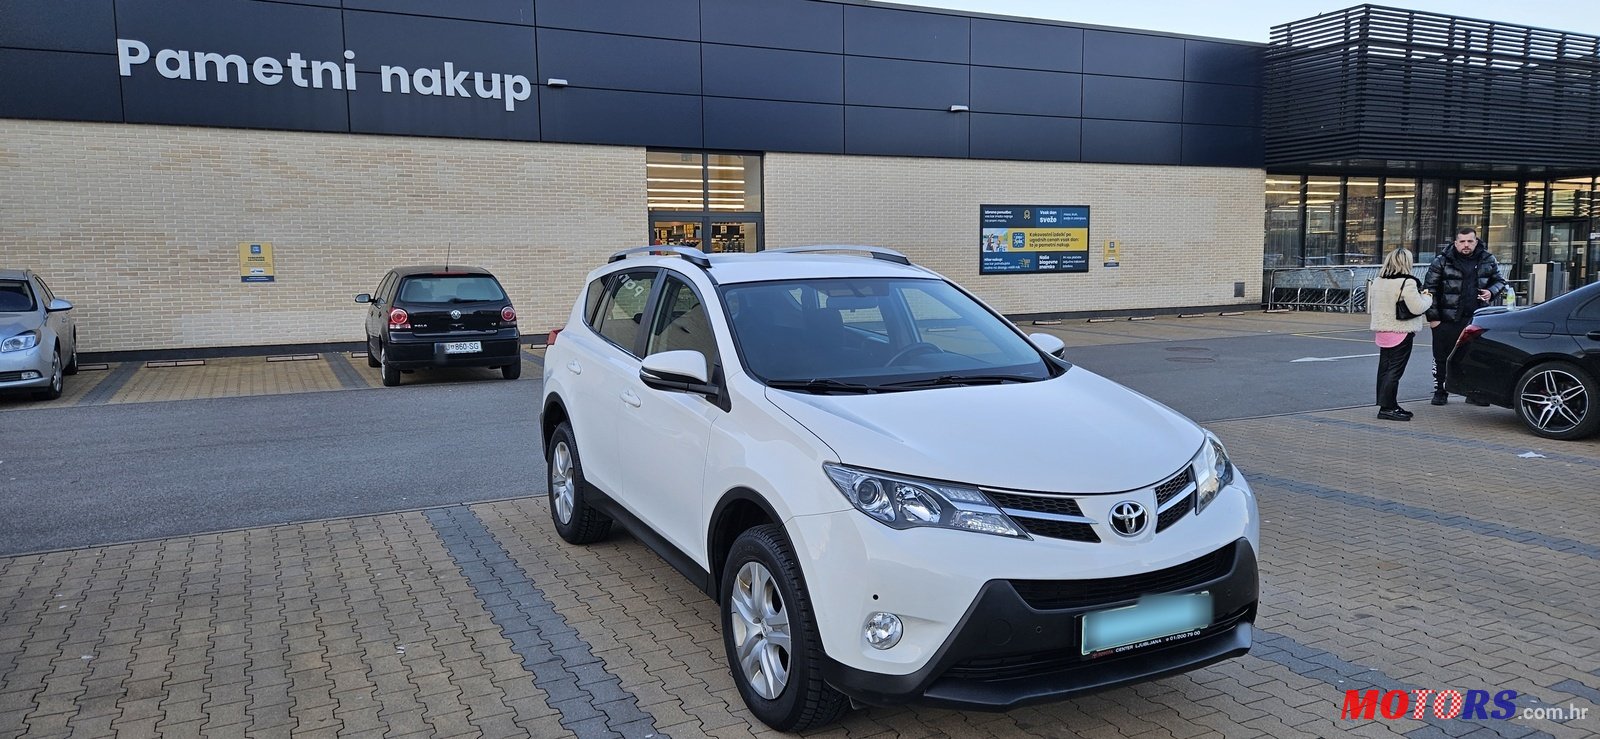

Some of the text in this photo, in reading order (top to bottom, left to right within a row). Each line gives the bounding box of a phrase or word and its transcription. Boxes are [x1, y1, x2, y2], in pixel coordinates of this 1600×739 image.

[117, 38, 532, 111] Pametni nakup
[1115, 645, 1134, 653] CENTER
[1135, 639, 1162, 648] LJUBLJANA
[1170, 633, 1187, 641] 01/200
